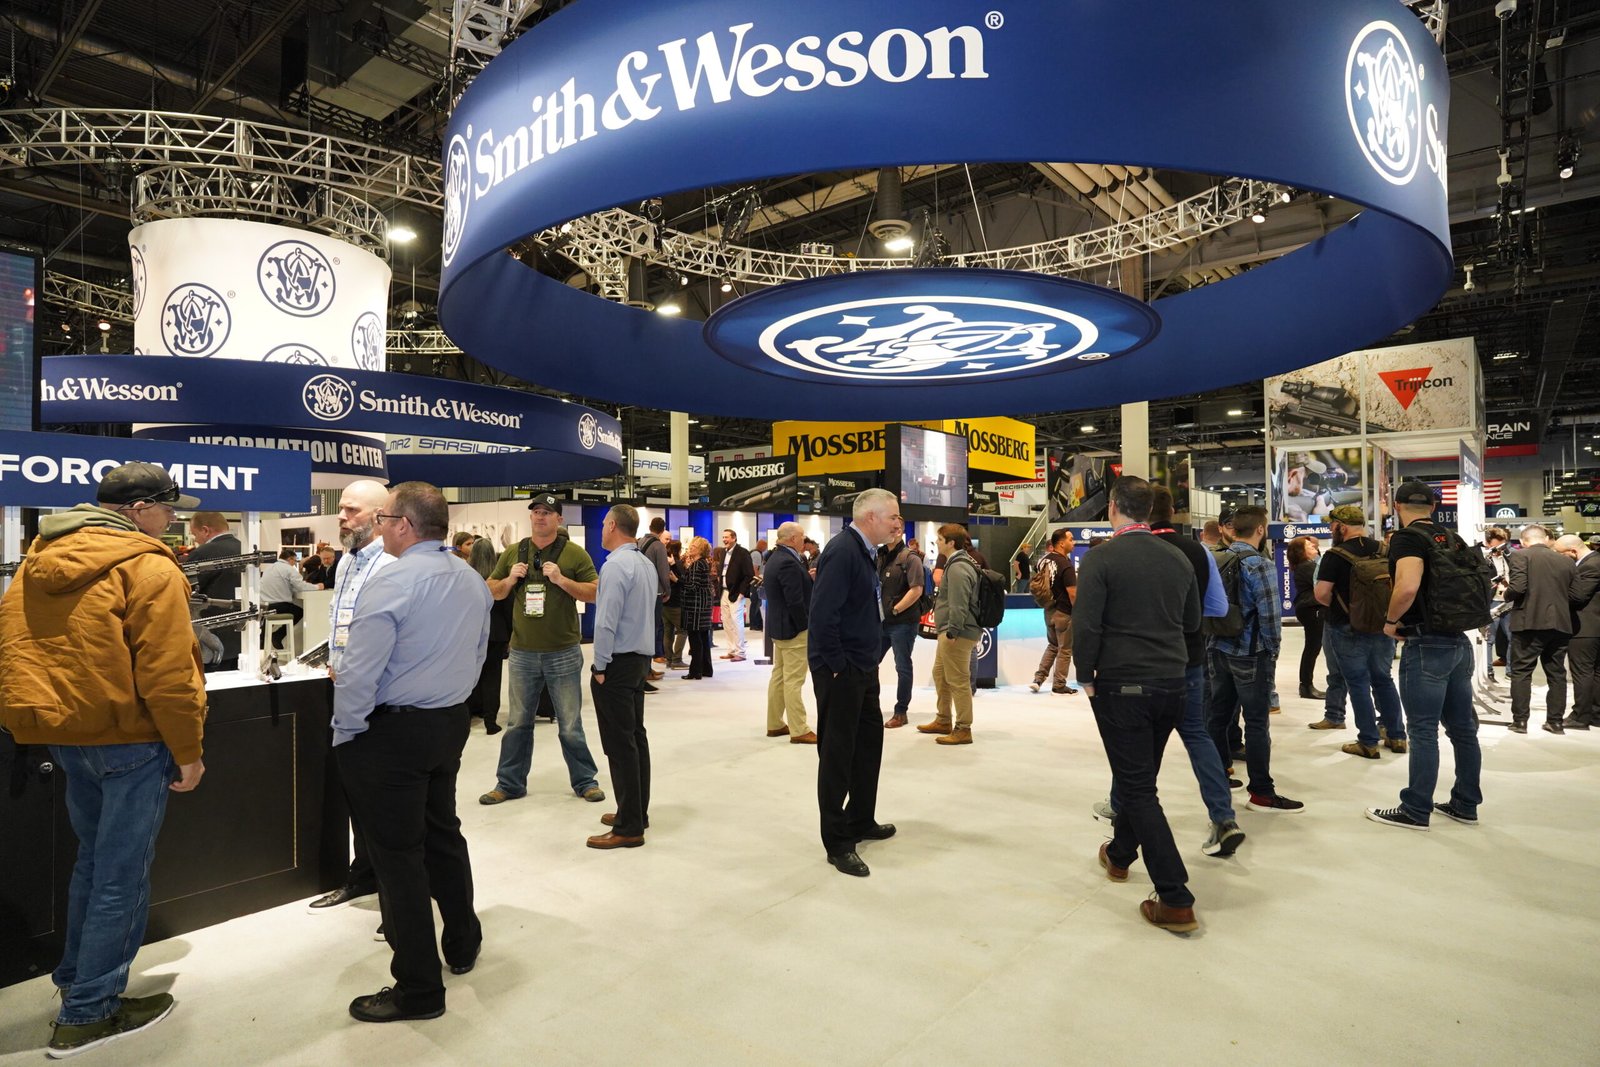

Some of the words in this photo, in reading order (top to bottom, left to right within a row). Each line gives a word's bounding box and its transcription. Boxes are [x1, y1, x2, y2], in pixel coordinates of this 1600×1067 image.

[1394, 376, 1453, 392] Trijicon
[788, 428, 886, 462] MOSSBE
[341, 442, 384, 469] CENTER
[632, 459, 703, 473] SARSIAZ
[717, 463, 785, 482] MOSSBERG
